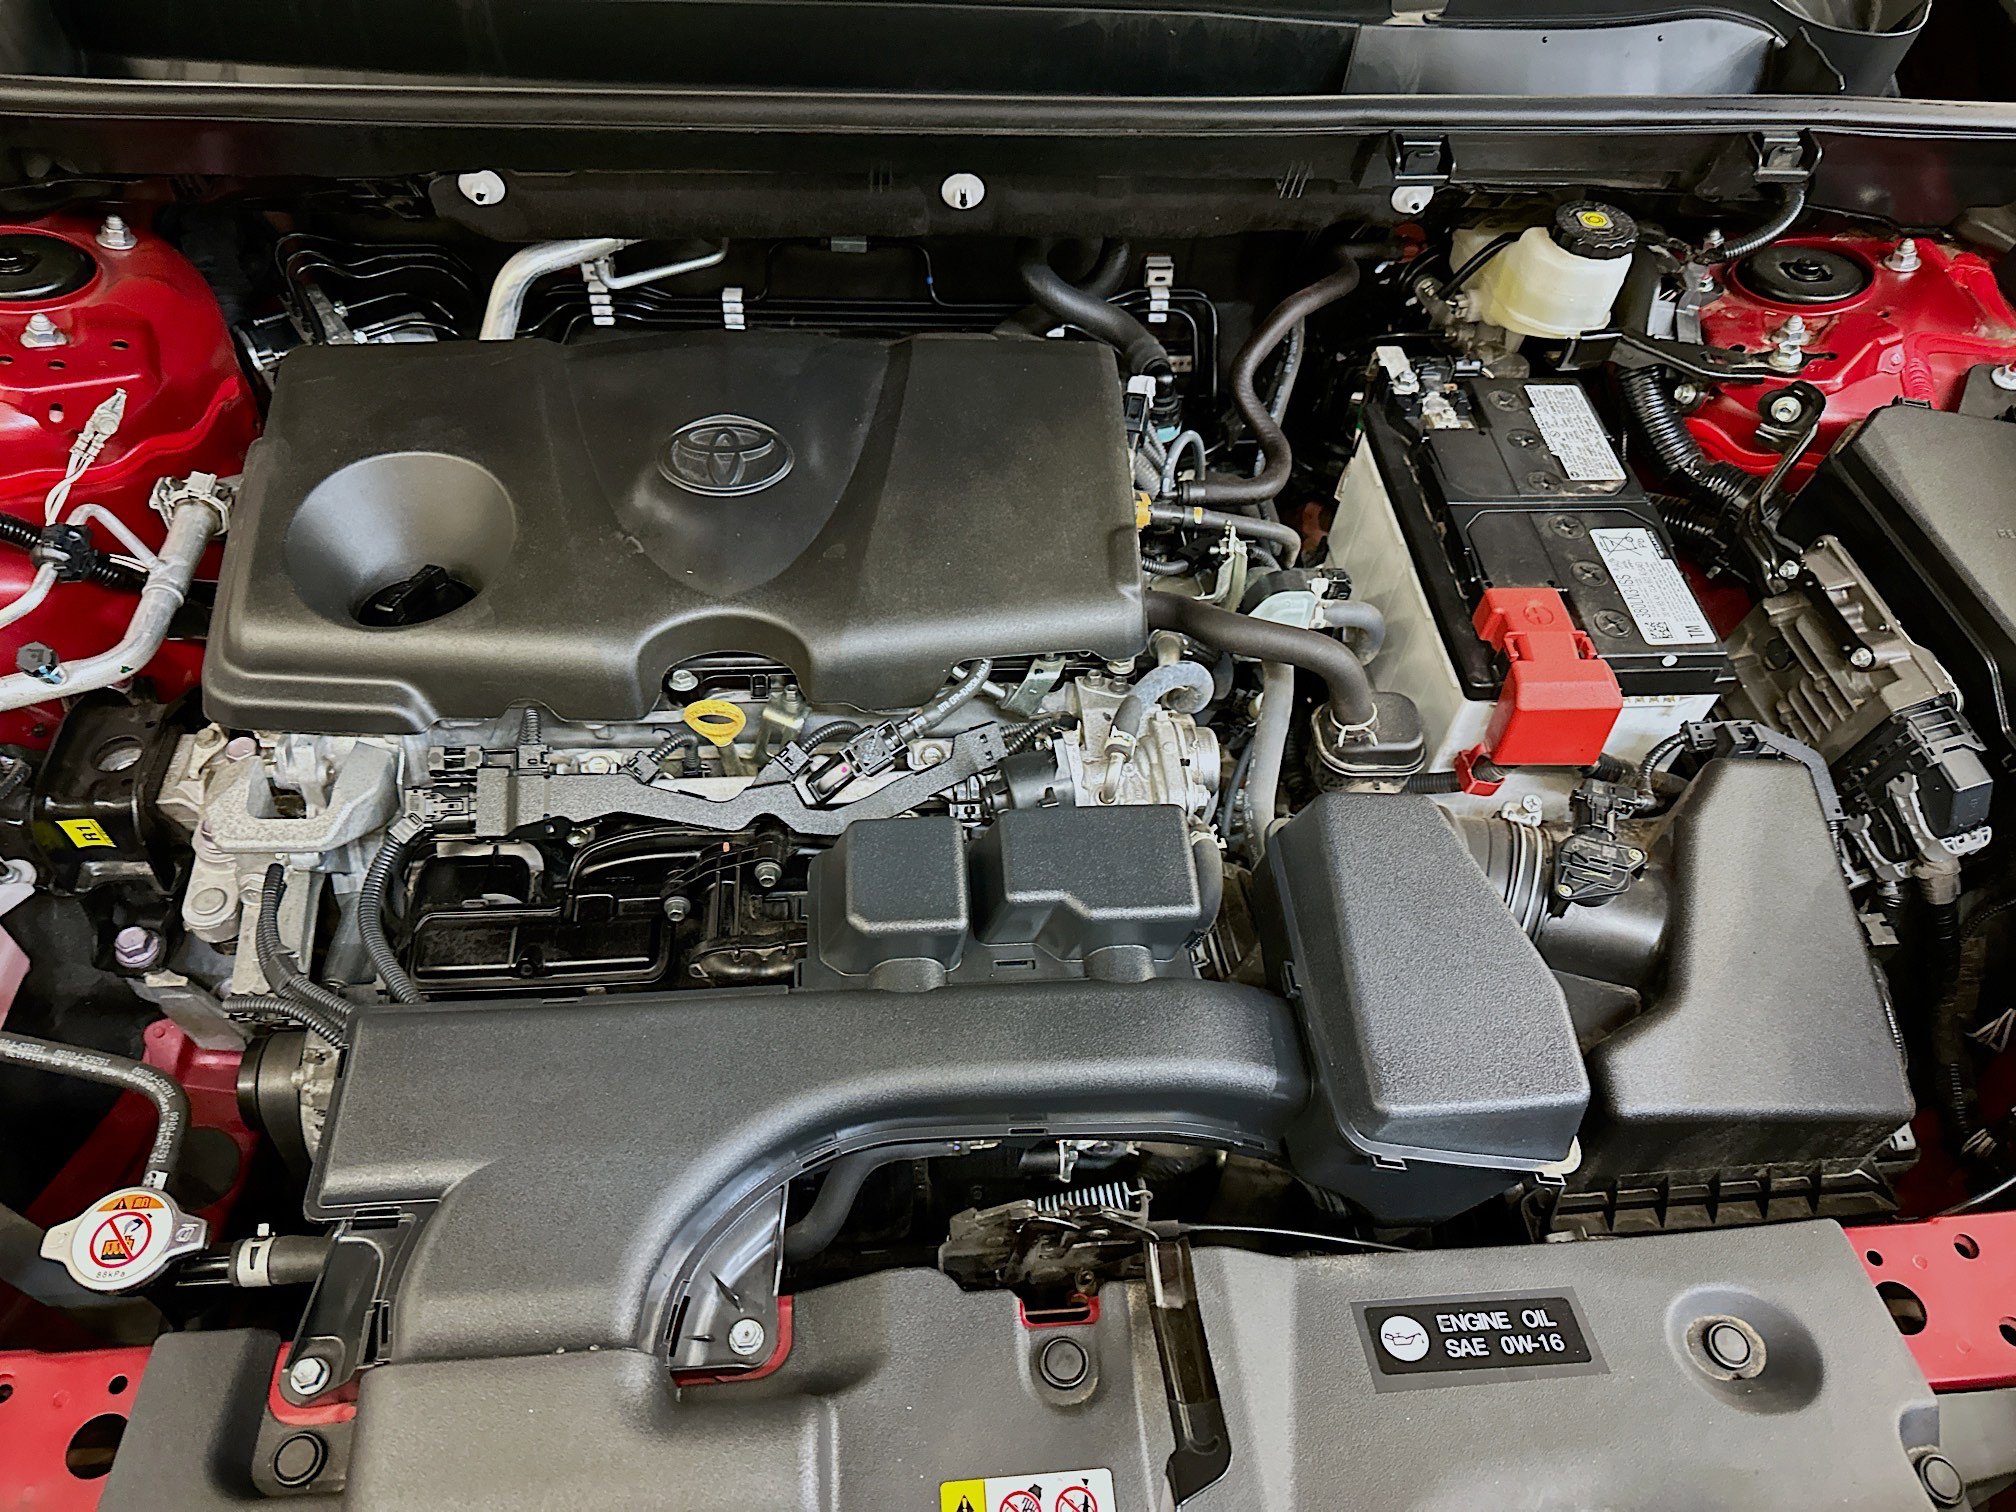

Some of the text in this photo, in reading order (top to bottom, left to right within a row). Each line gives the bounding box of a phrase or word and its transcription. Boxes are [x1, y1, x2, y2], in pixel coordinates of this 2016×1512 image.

[1684, 624, 1706, 639] TM
[76, 826, 102, 841] R1
[95, 1270, 126, 1279] 88kPa
[1436, 1309, 1558, 1333] ENGINE OIL
[1445, 1333, 1566, 1358] SAE 0W-16
